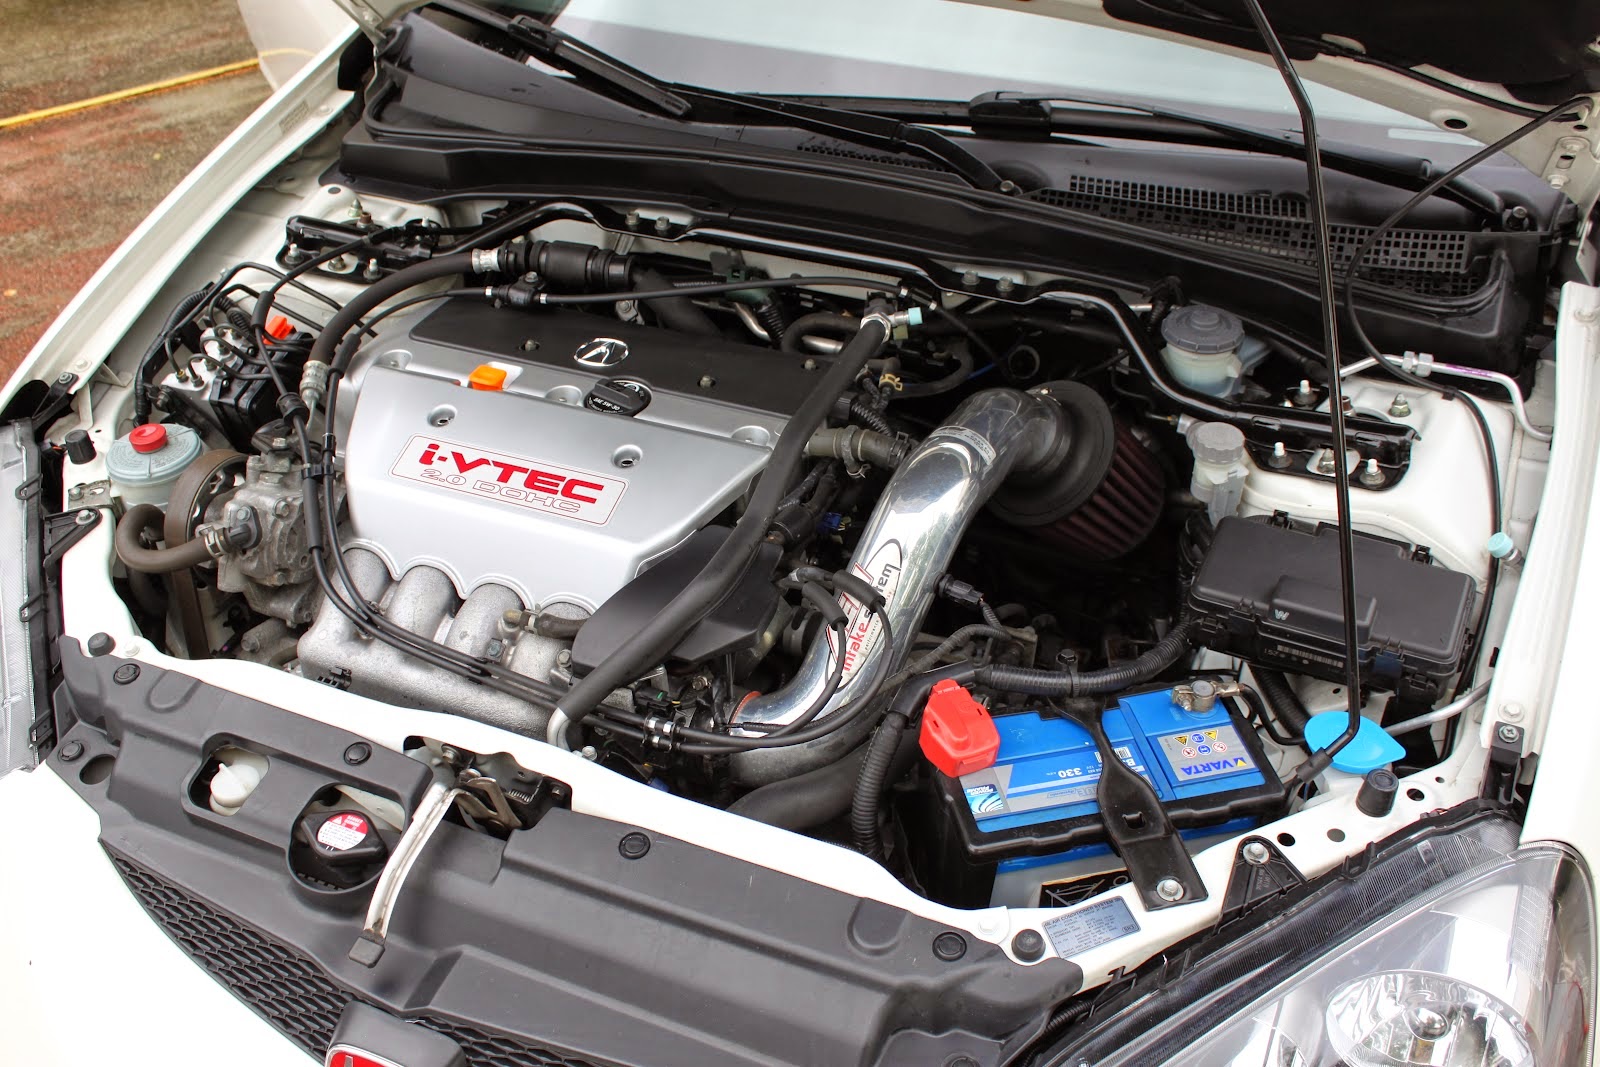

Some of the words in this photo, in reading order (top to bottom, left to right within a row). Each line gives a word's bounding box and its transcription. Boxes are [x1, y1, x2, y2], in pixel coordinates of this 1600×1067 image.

[603, 401, 620, 410] 5W-30
[419, 443, 605, 504] i-VTEC
[420, 467, 467, 486] 2.0
[472, 480, 581, 513] DOHC
[1057, 766, 1083, 778] 330
[1181, 758, 1234, 776] VARTA
[1094, 900, 1114, 910] SYSTEM
